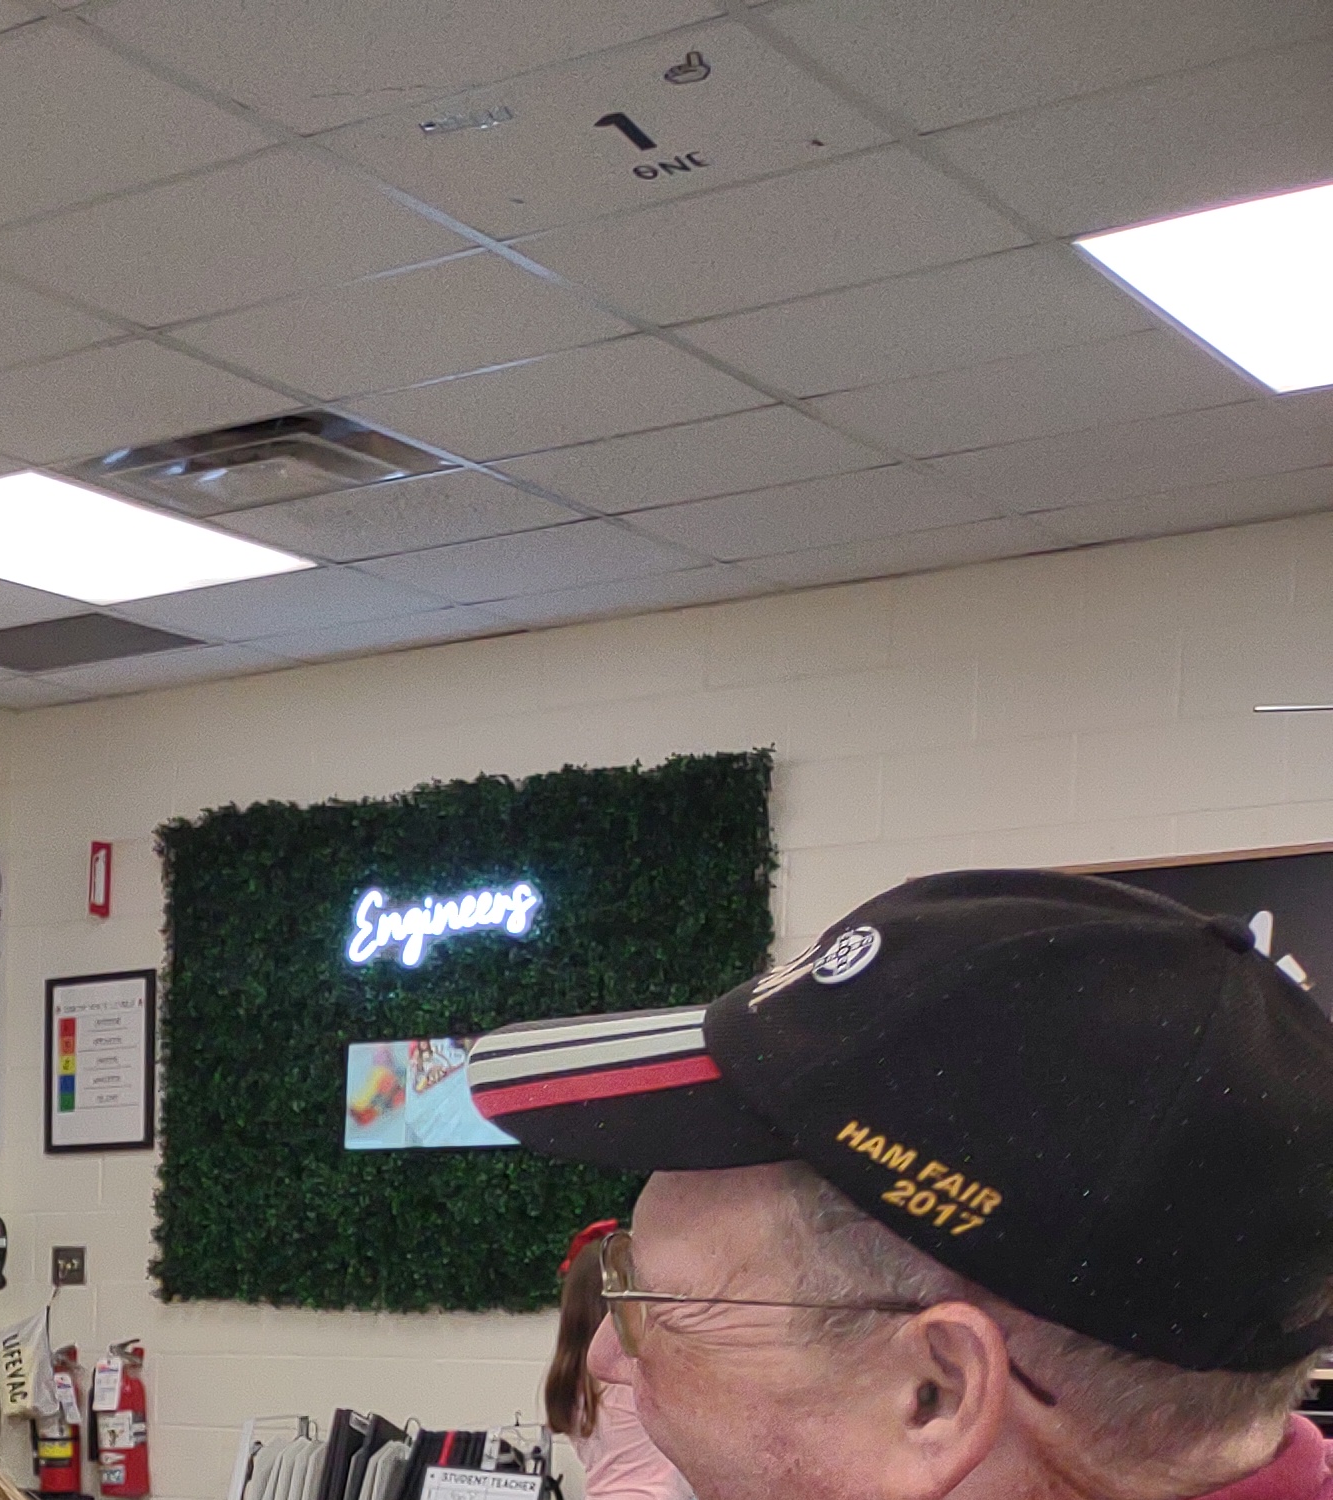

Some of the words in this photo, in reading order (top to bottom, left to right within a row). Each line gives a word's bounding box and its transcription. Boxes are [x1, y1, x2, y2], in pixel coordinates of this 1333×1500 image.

[593, 112, 658, 151] 1
[348, 882, 541, 968] Engineers
[835, 1119, 918, 1173] HAM
[917, 1159, 1003, 1215] FAIR
[881, 1179, 986, 1237] 2017
[441, 1472, 488, 1486] STUDENT
[490, 1477, 537, 1492] TEACHER
